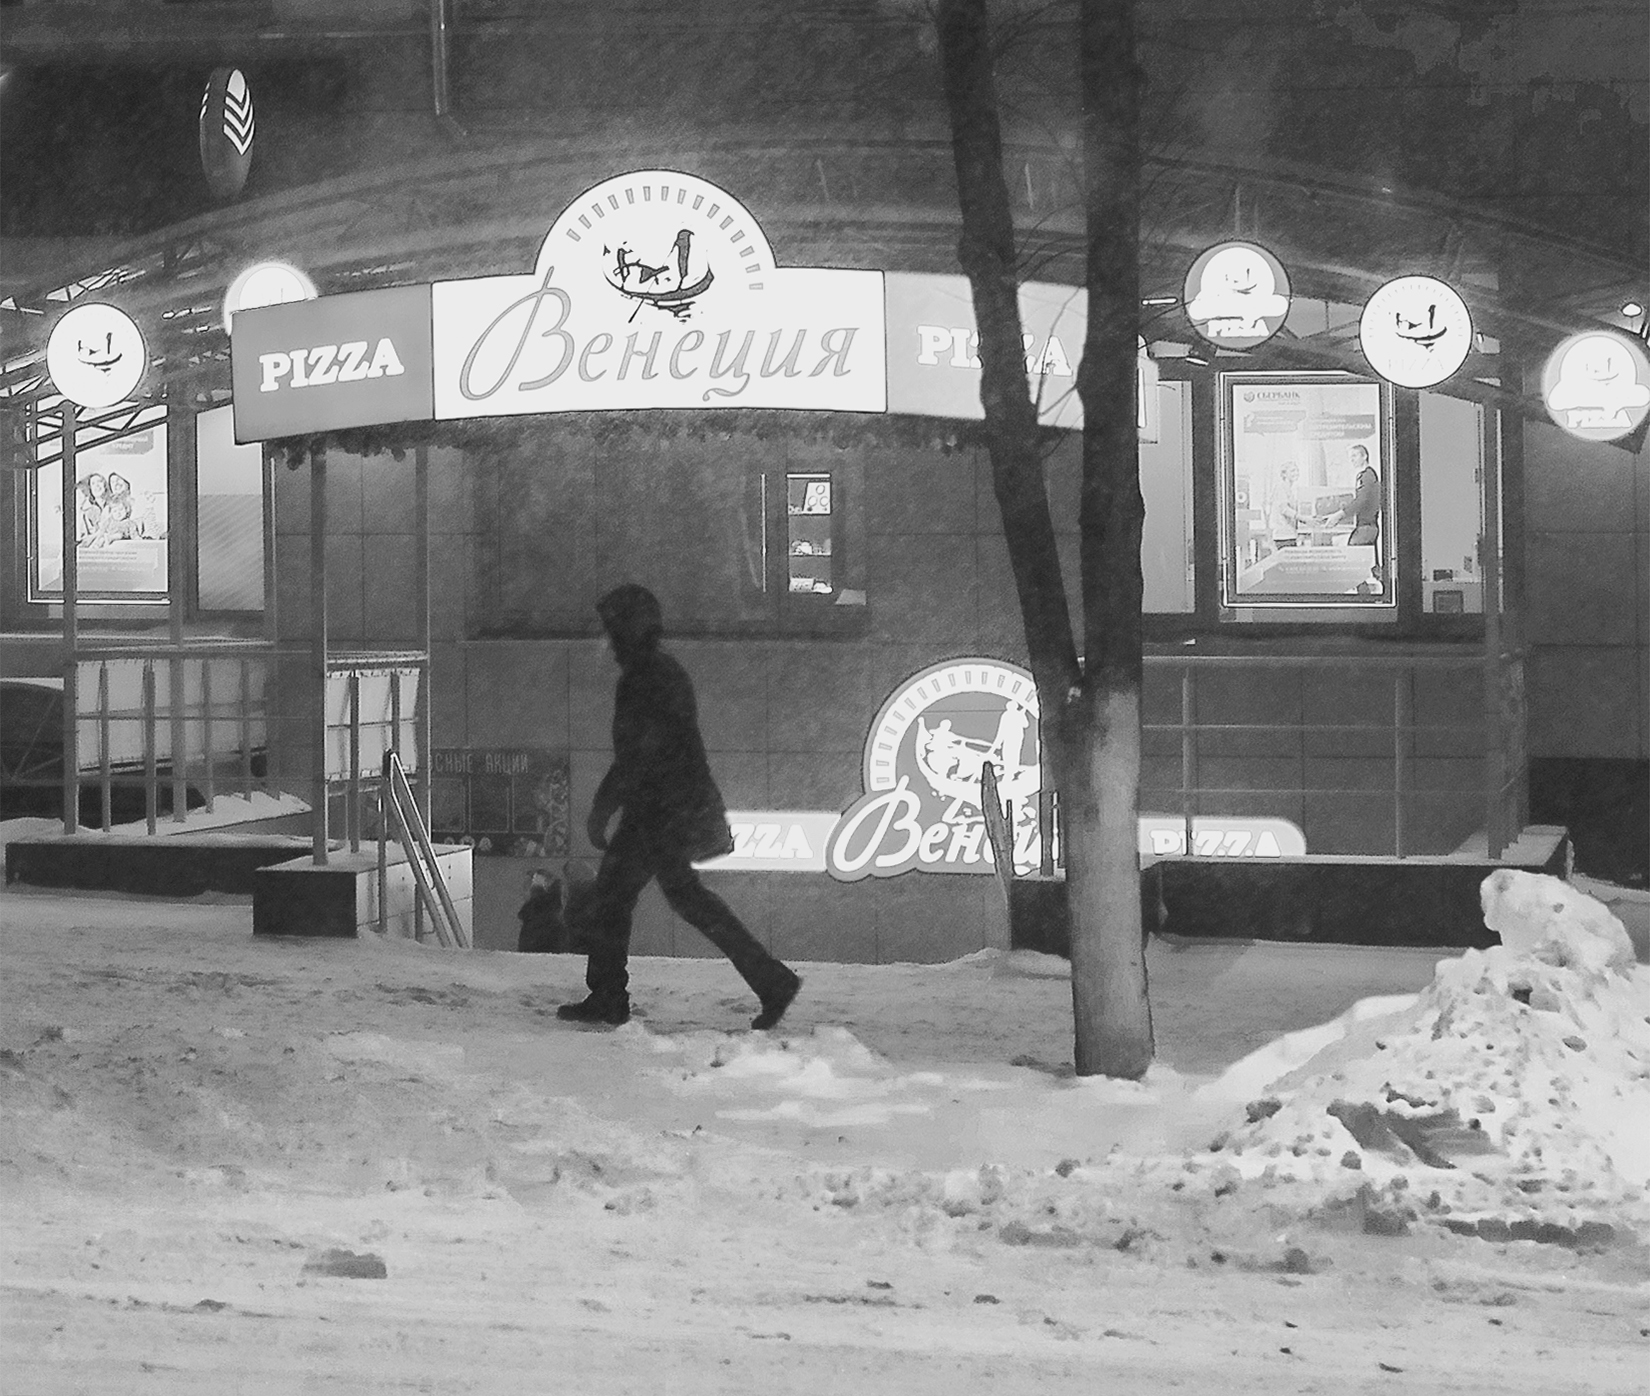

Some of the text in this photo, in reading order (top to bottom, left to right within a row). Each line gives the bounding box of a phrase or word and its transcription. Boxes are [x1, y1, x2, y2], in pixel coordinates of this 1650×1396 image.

[460, 266, 859, 401] Венеция
[258, 338, 405, 392] PIZZA
[430, 753, 473, 773] СНЫЕ
[729, 823, 814, 859] ZZA
